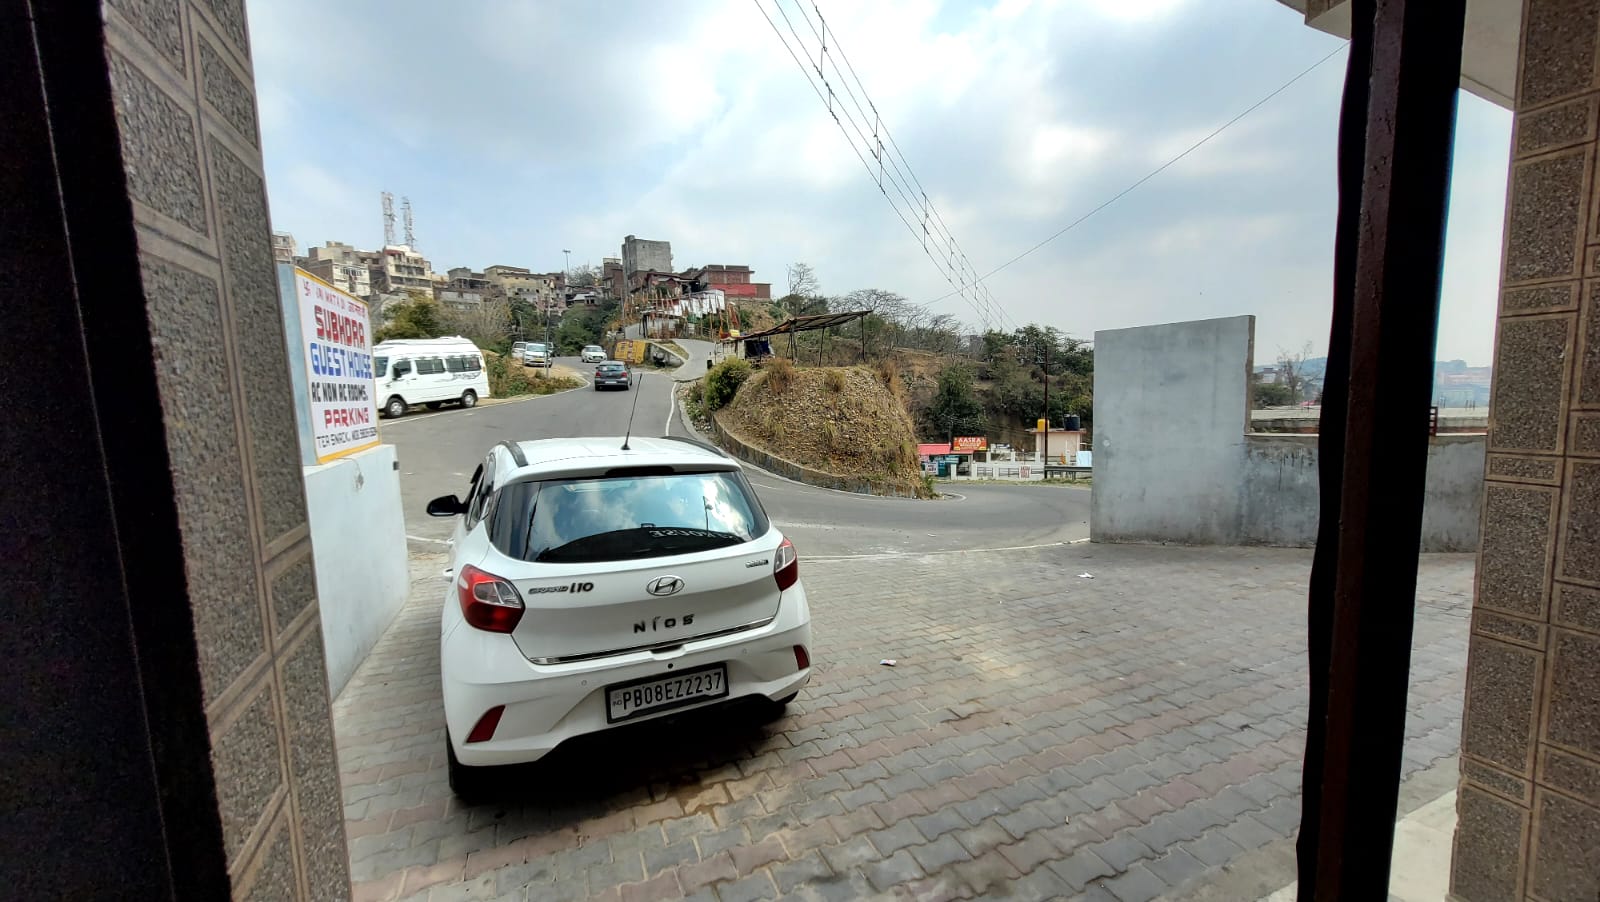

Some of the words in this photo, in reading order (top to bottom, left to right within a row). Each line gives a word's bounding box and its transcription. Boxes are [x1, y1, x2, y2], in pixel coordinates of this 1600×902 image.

[310, 342, 346, 377] GUEST
[347, 350, 372, 380] HOUSE
[311, 381, 321, 402] AC
[321, 382, 338, 402] NON
[338, 383, 347, 402] AC
[323, 407, 369, 429] PARKING
[622, 671, 722, 710] PB08EZ2237
